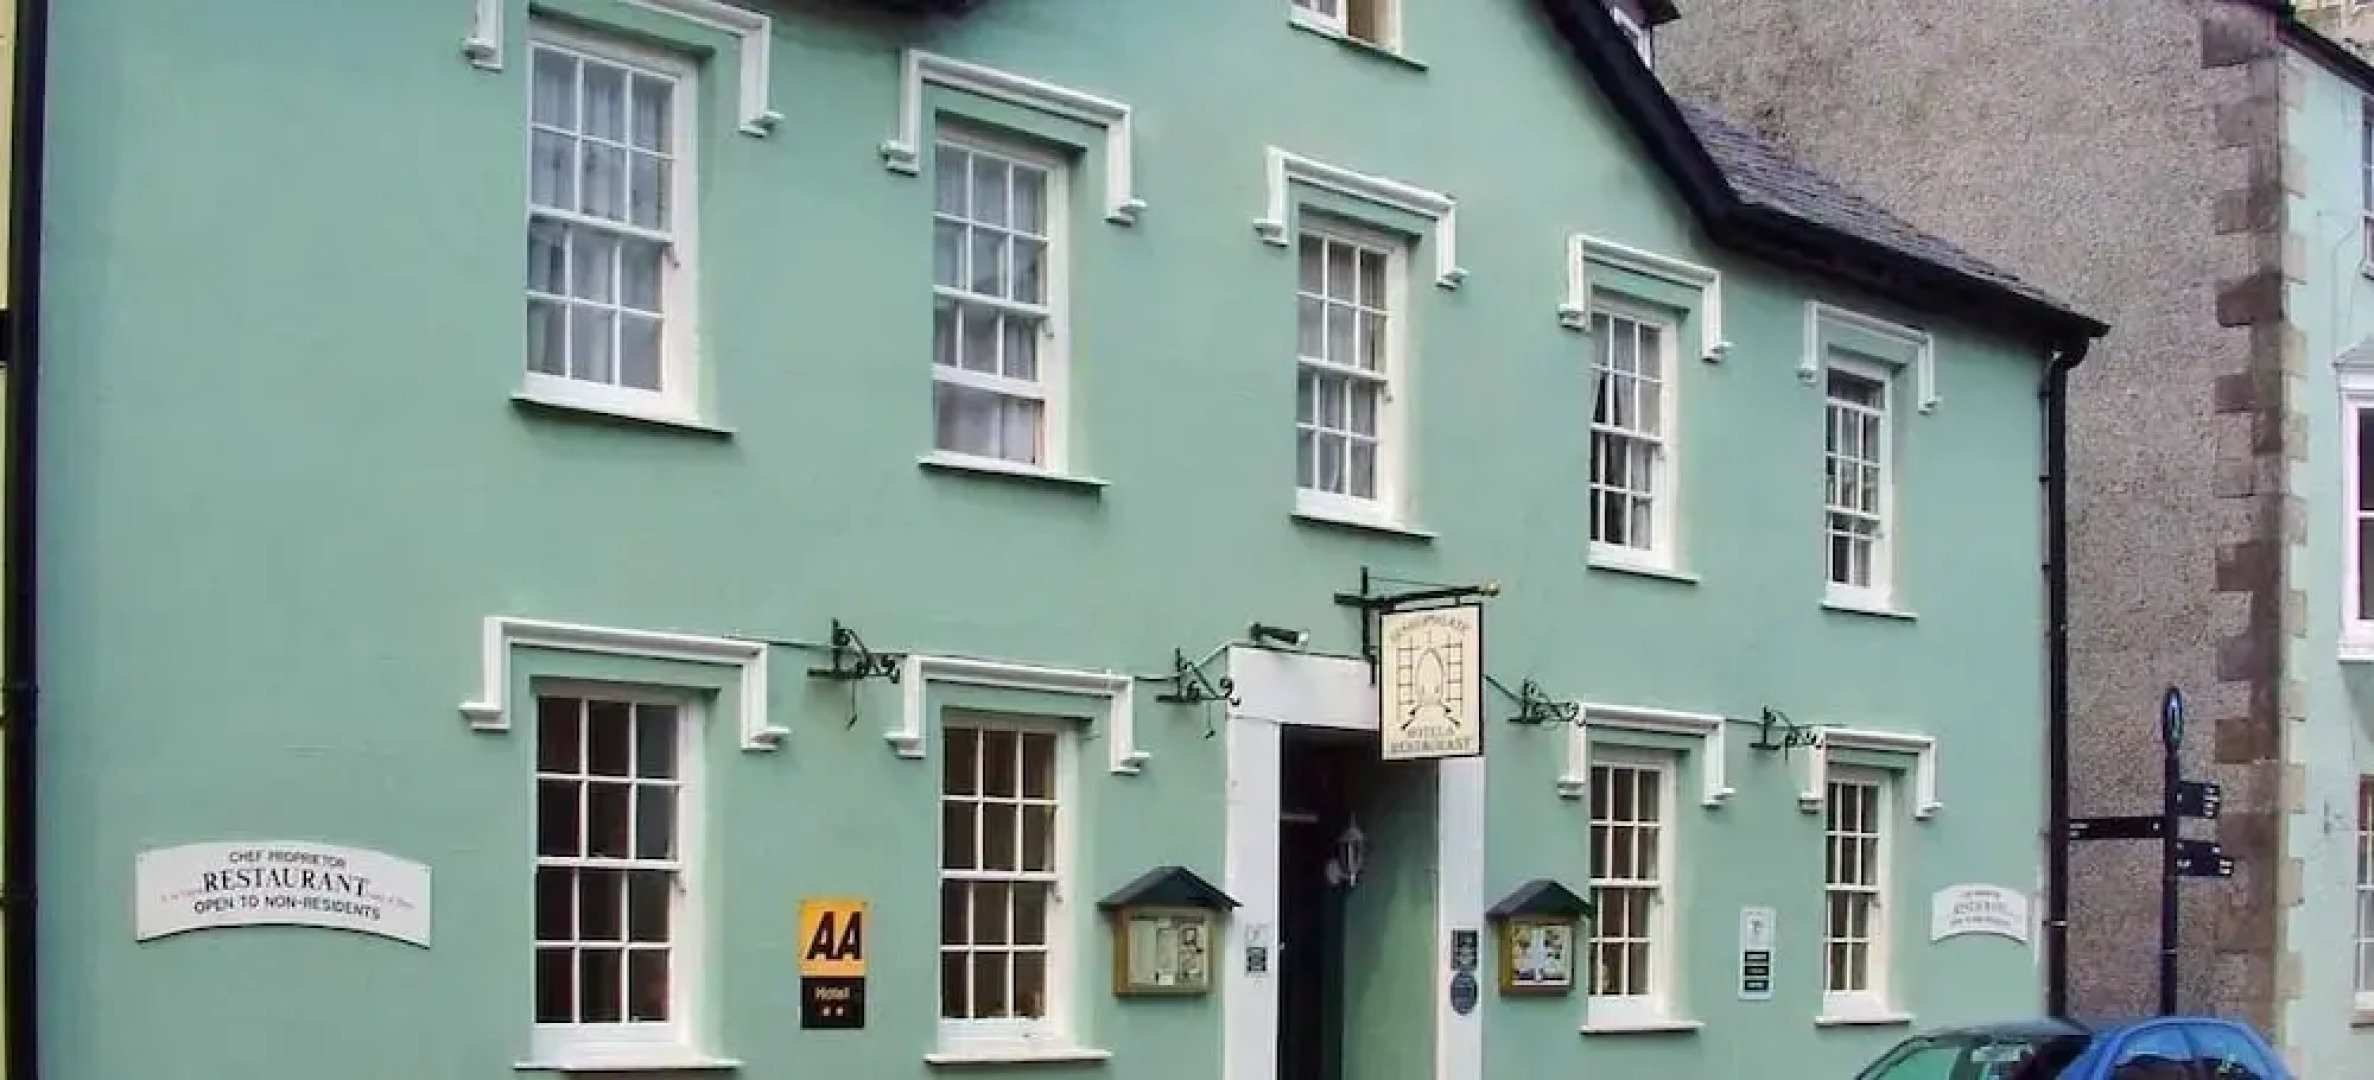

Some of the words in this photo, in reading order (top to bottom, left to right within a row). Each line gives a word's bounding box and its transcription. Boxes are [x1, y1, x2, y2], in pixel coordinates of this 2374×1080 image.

[229, 850, 263, 864] CHEF
[267, 850, 347, 868] PROPRIETOR
[202, 868, 371, 898] RESTAURANT
[194, 897, 235, 914] OPEN
[240, 895, 259, 908] TO
[265, 895, 381, 921] NON-RESIDENTS
[806, 910, 862, 961] AA
